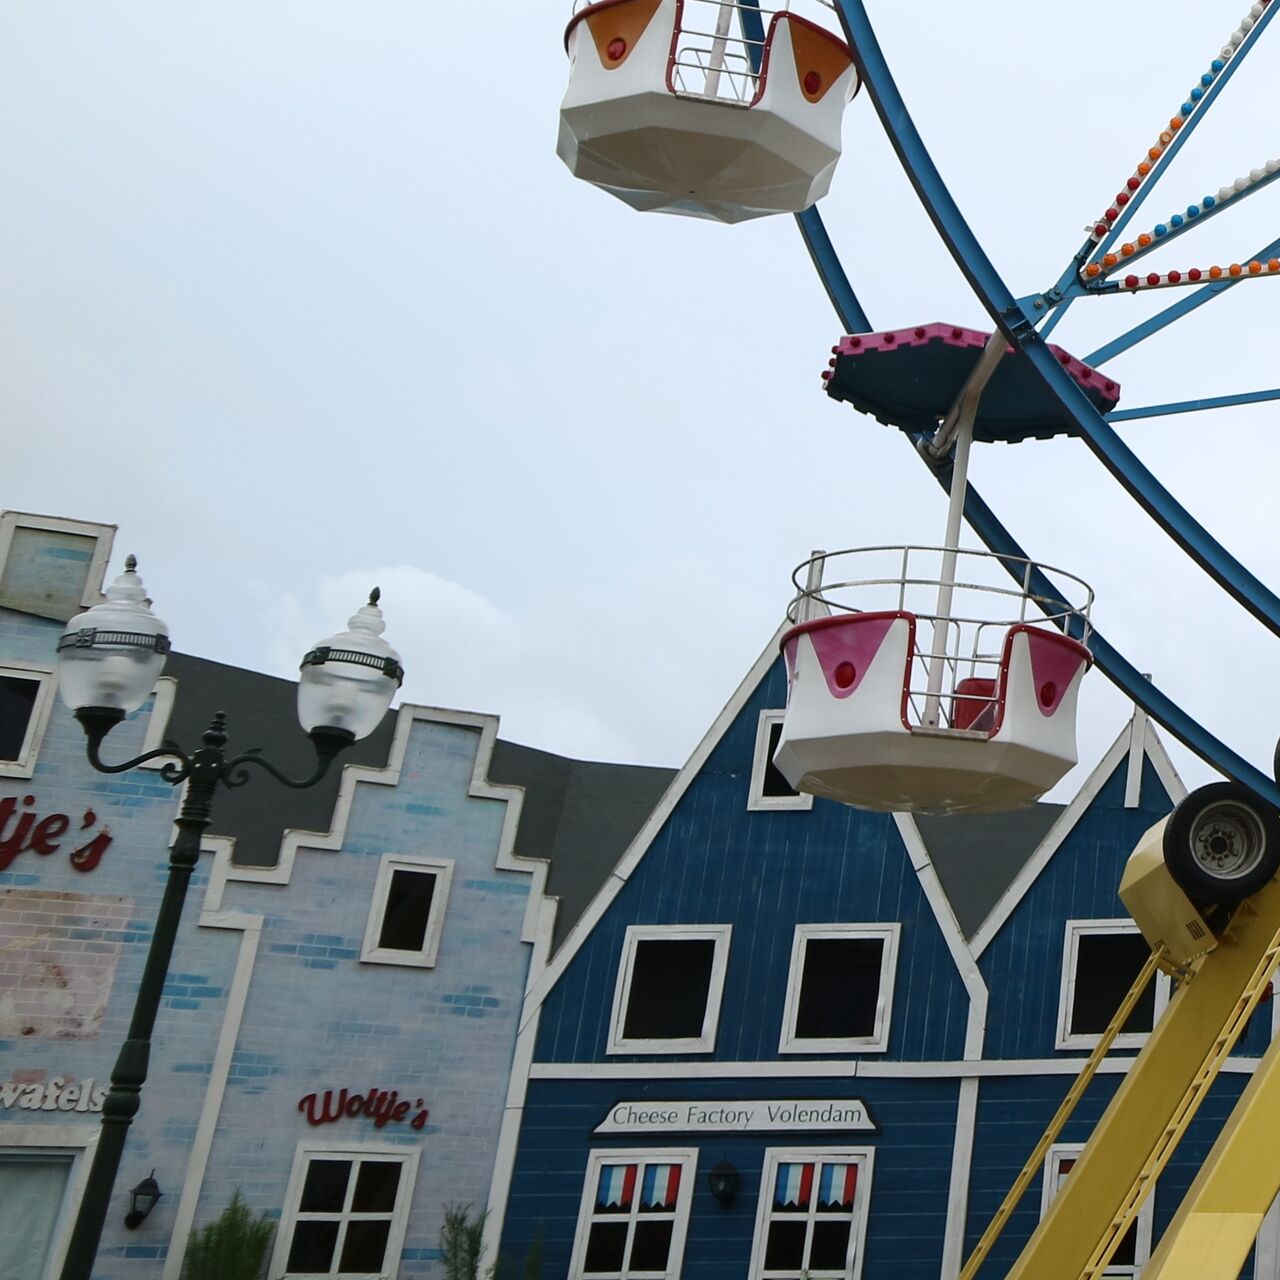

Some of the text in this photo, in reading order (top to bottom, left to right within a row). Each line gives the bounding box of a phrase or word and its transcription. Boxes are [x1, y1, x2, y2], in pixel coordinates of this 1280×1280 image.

[297, 1087, 429, 1131] Woltje's
[612, 1103, 863, 1129] Cheese Factory Volendam
